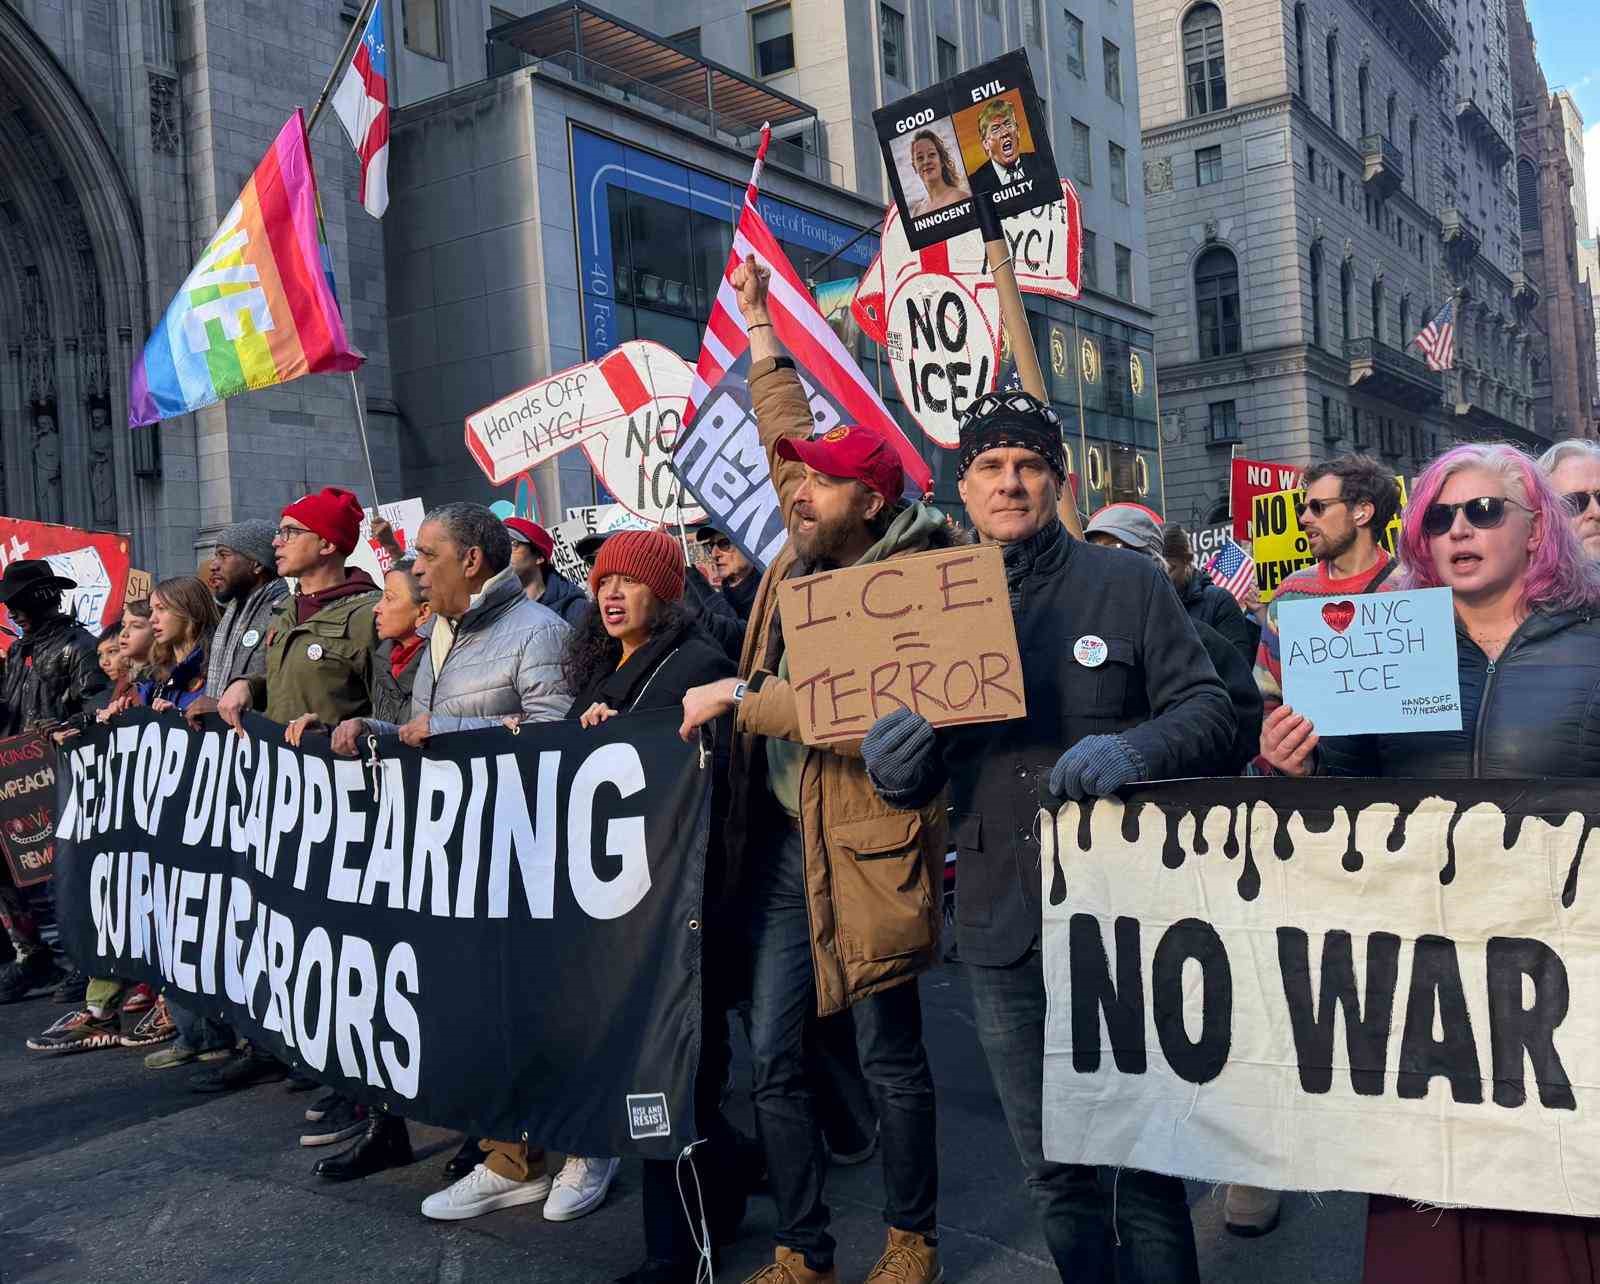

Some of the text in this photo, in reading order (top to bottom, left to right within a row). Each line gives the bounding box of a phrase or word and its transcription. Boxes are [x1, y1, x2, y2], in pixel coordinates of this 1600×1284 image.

[971, 79, 1006, 103] EVIL
[896, 108, 935, 134] GOOD
[992, 179, 1034, 204] GUILTY
[914, 202, 971, 232] INNOCENT
[591, 262, 609, 297] 40
[906, 291, 968, 352] NO
[484, 374, 588, 447] Hands Off
[522, 404, 585, 458] NYC!
[625, 408, 681, 459] NO
[1247, 465, 1272, 488] NO
[1256, 495, 1287, 538] NO
[791, 555, 994, 631] I.C.E.
[1361, 600, 1413, 626] NYC
[1289, 628, 1425, 666] ABOLISH
[793, 652, 1023, 733] TERROR
[1334, 663, 1401, 694] ICE
[1401, 694, 1452, 706] HANDS OFF
[98, 722, 189, 837] STOP
[181, 728, 652, 920] DISAPPEARING
[19, 846, 55, 870] REM
[1069, 912, 1577, 1110] NO WAR
